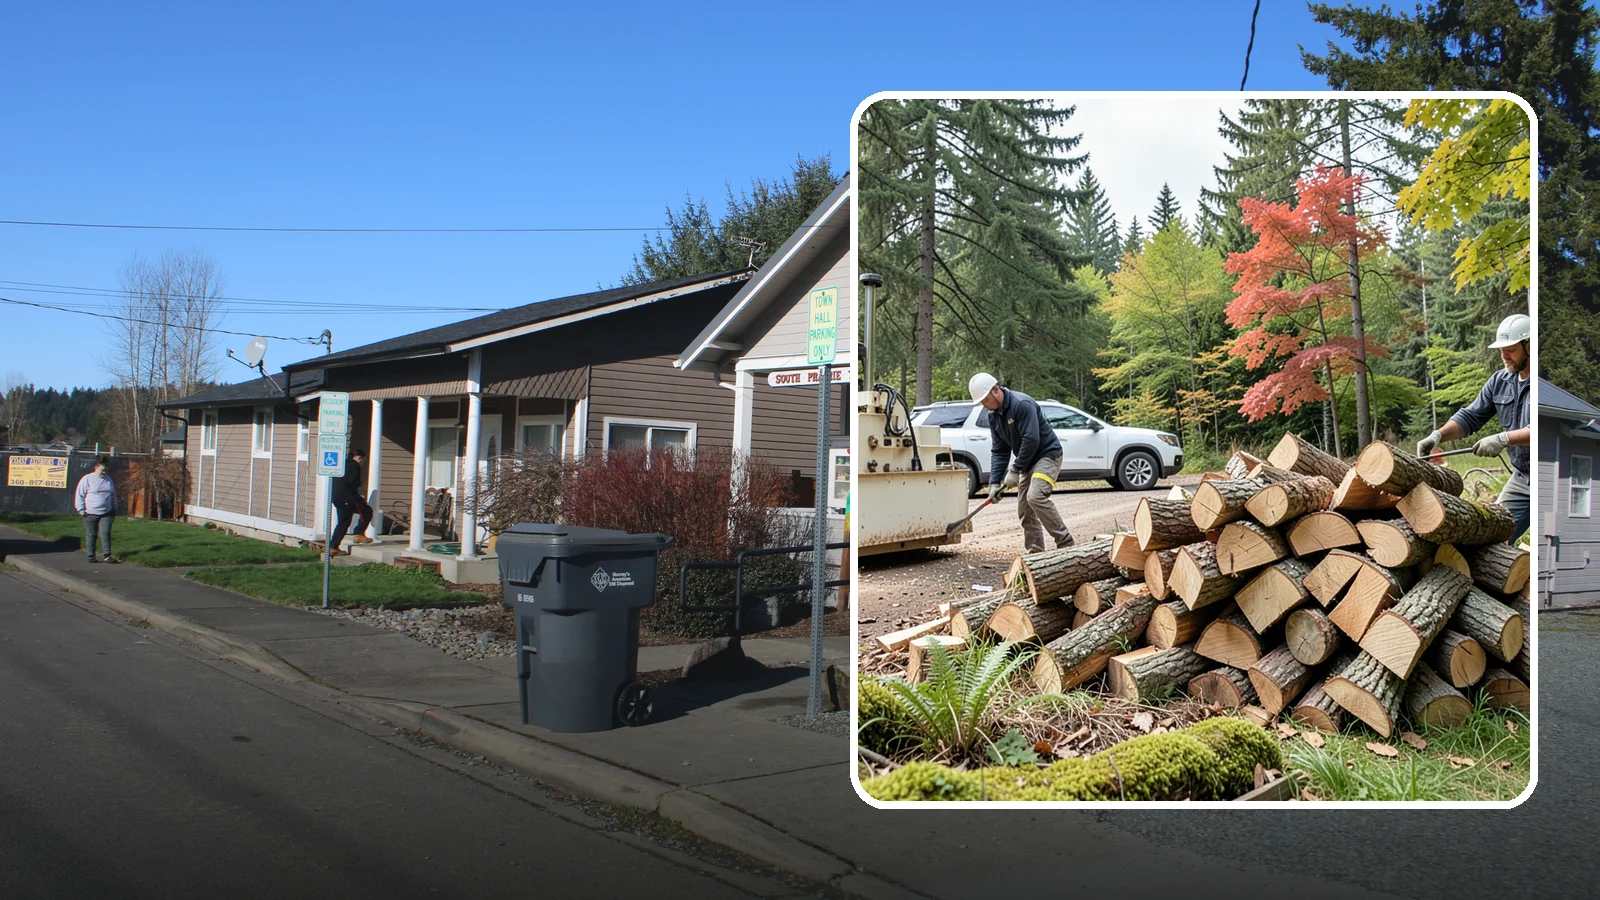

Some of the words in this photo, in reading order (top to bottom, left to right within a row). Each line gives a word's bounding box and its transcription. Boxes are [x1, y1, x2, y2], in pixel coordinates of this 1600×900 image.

[815, 295, 833, 308] TOWN
[815, 312, 831, 324] HALL
[810, 327, 835, 340] PARKING
[814, 344, 830, 357] ONLY
[775, 373, 801, 384] SOUTH
[807, 370, 842, 382] PRIE
